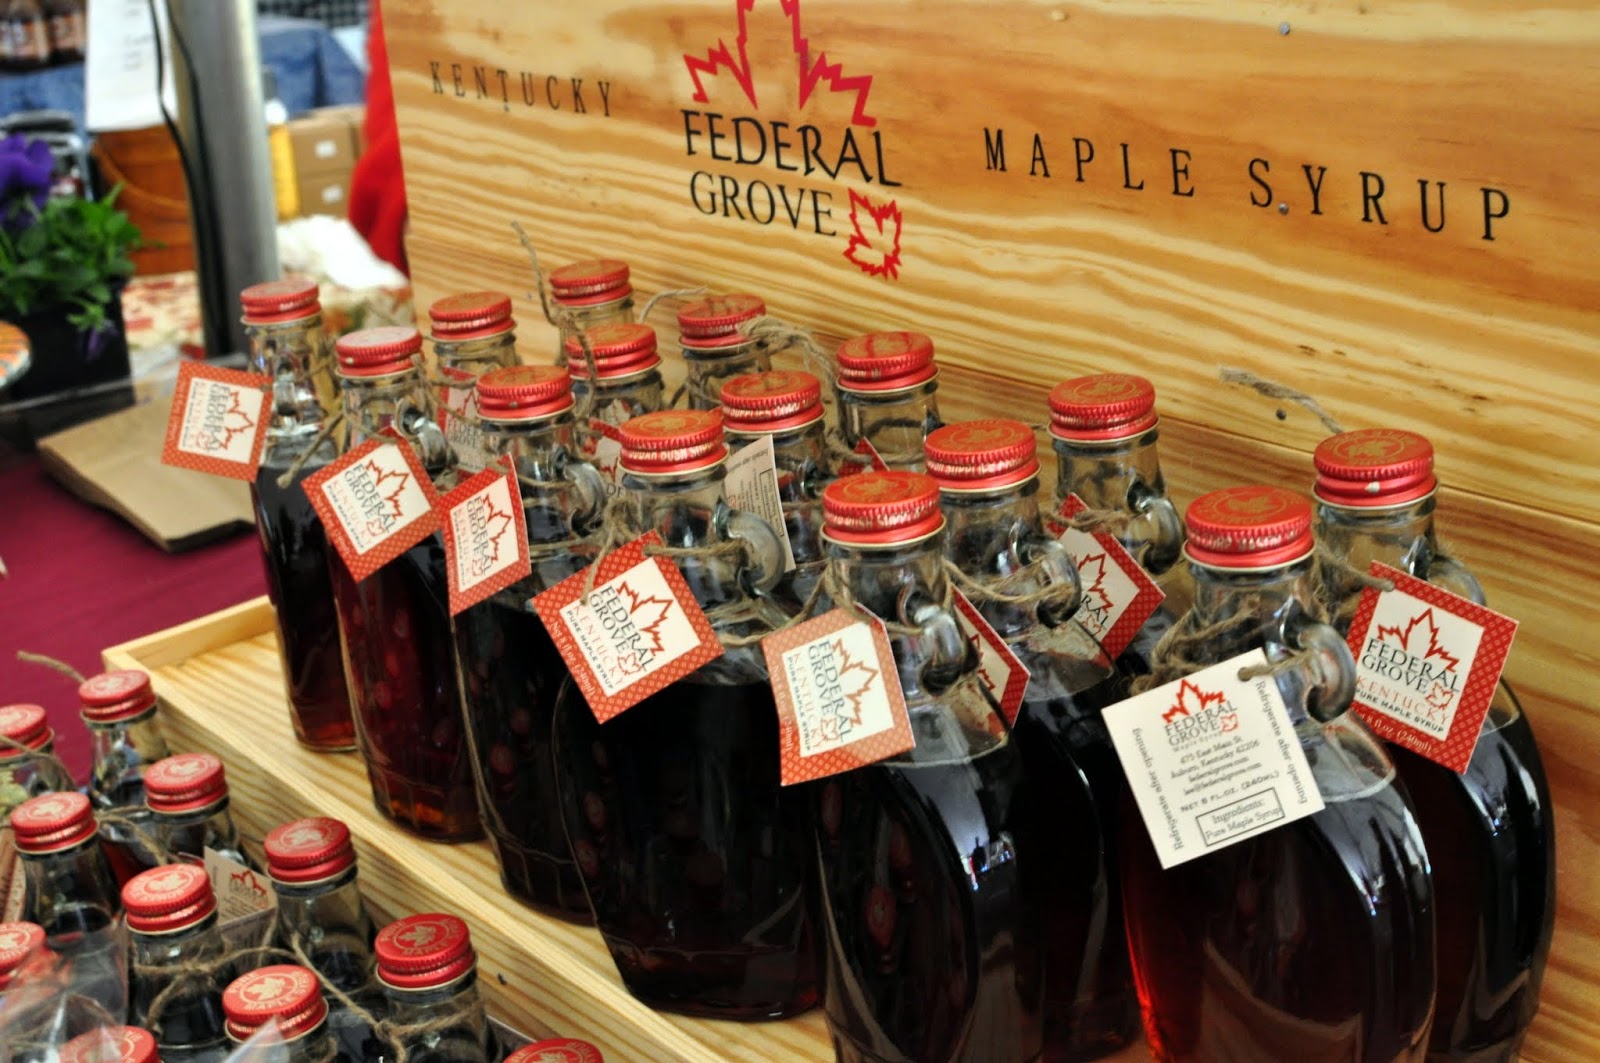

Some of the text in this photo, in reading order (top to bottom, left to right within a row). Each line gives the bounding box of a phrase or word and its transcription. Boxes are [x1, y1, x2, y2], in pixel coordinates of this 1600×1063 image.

[429, 61, 611, 117] KENTUCKY
[681, 109, 902, 187] FEDERAL
[689, 170, 837, 237] GROVE
[984, 127, 1510, 242] MAPLE SYRUP
[342, 468, 376, 520] GROVE
[352, 462, 397, 534] FEDERAL
[474, 494, 492, 576] FEDERAL
[566, 609, 582, 632] PURE
[596, 662, 614, 689] SYRUP
[587, 591, 630, 654] GROVE
[599, 585, 656, 672] FEDERAL
[807, 643, 834, 716] GROVE
[817, 639, 855, 742] FEDERAL
[1359, 652, 1430, 694] GROVE
[1364, 636, 1465, 693] FEDERAL
[1163, 699, 1237, 736] FEDERAL
[1167, 718, 1220, 747] GROVE
[1354, 675, 1450, 726] KENTUCKY
[1380, 699, 1412, 718] MAPLE
[1413, 715, 1444, 733] SYRUP
